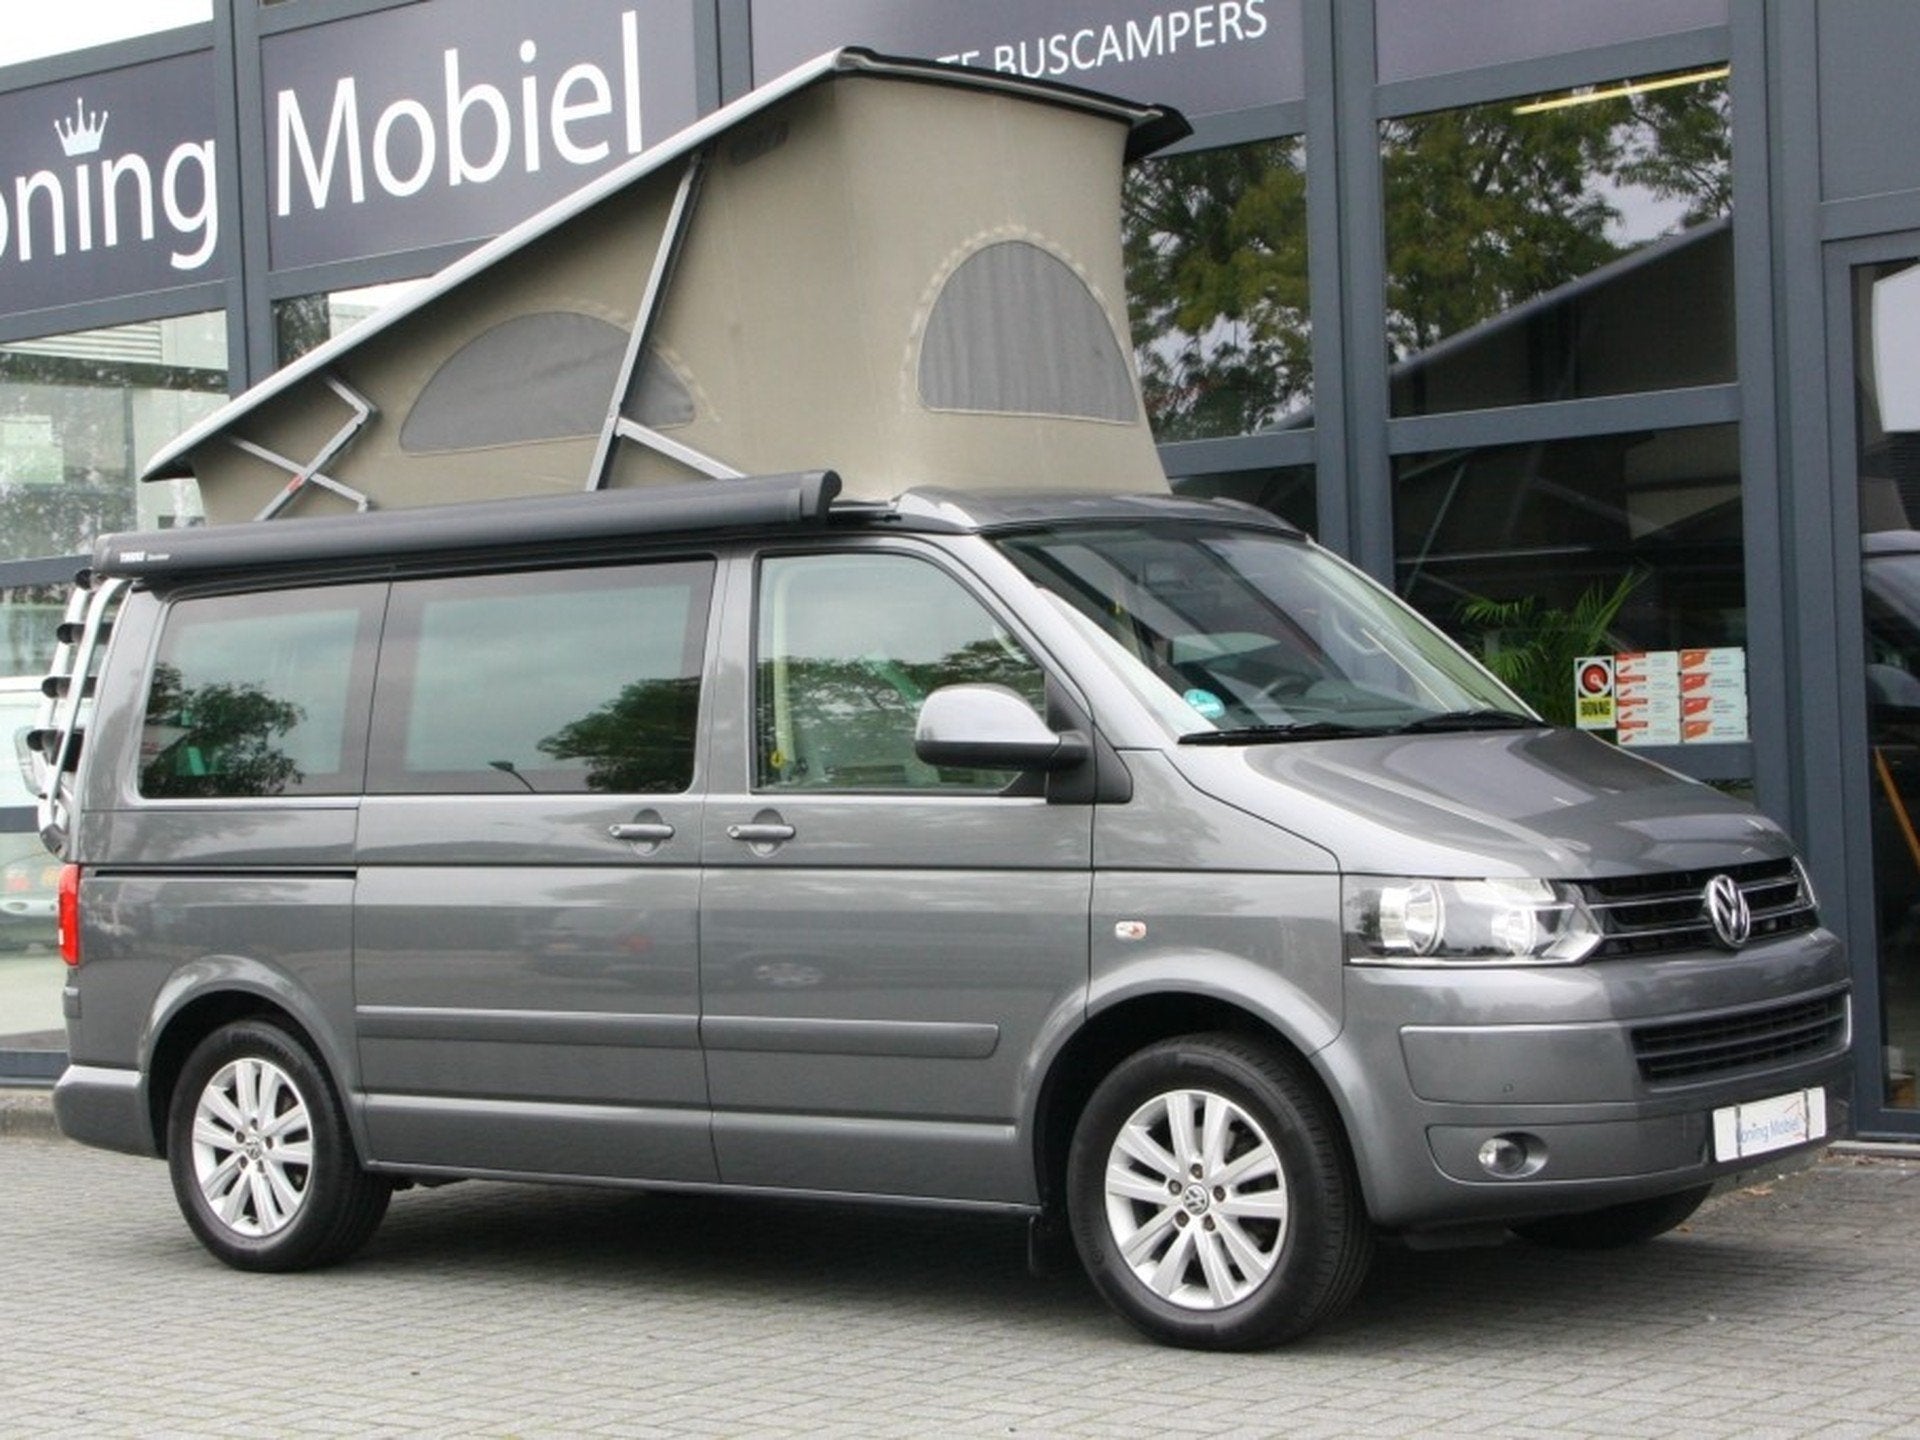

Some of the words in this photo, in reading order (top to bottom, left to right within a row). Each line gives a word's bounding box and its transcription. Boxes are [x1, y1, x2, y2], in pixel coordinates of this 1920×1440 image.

[995, 0, 1267, 79] BUSCAMPERS
[0, 140, 218, 270] ning
[278, 10, 642, 217] Mobiel
